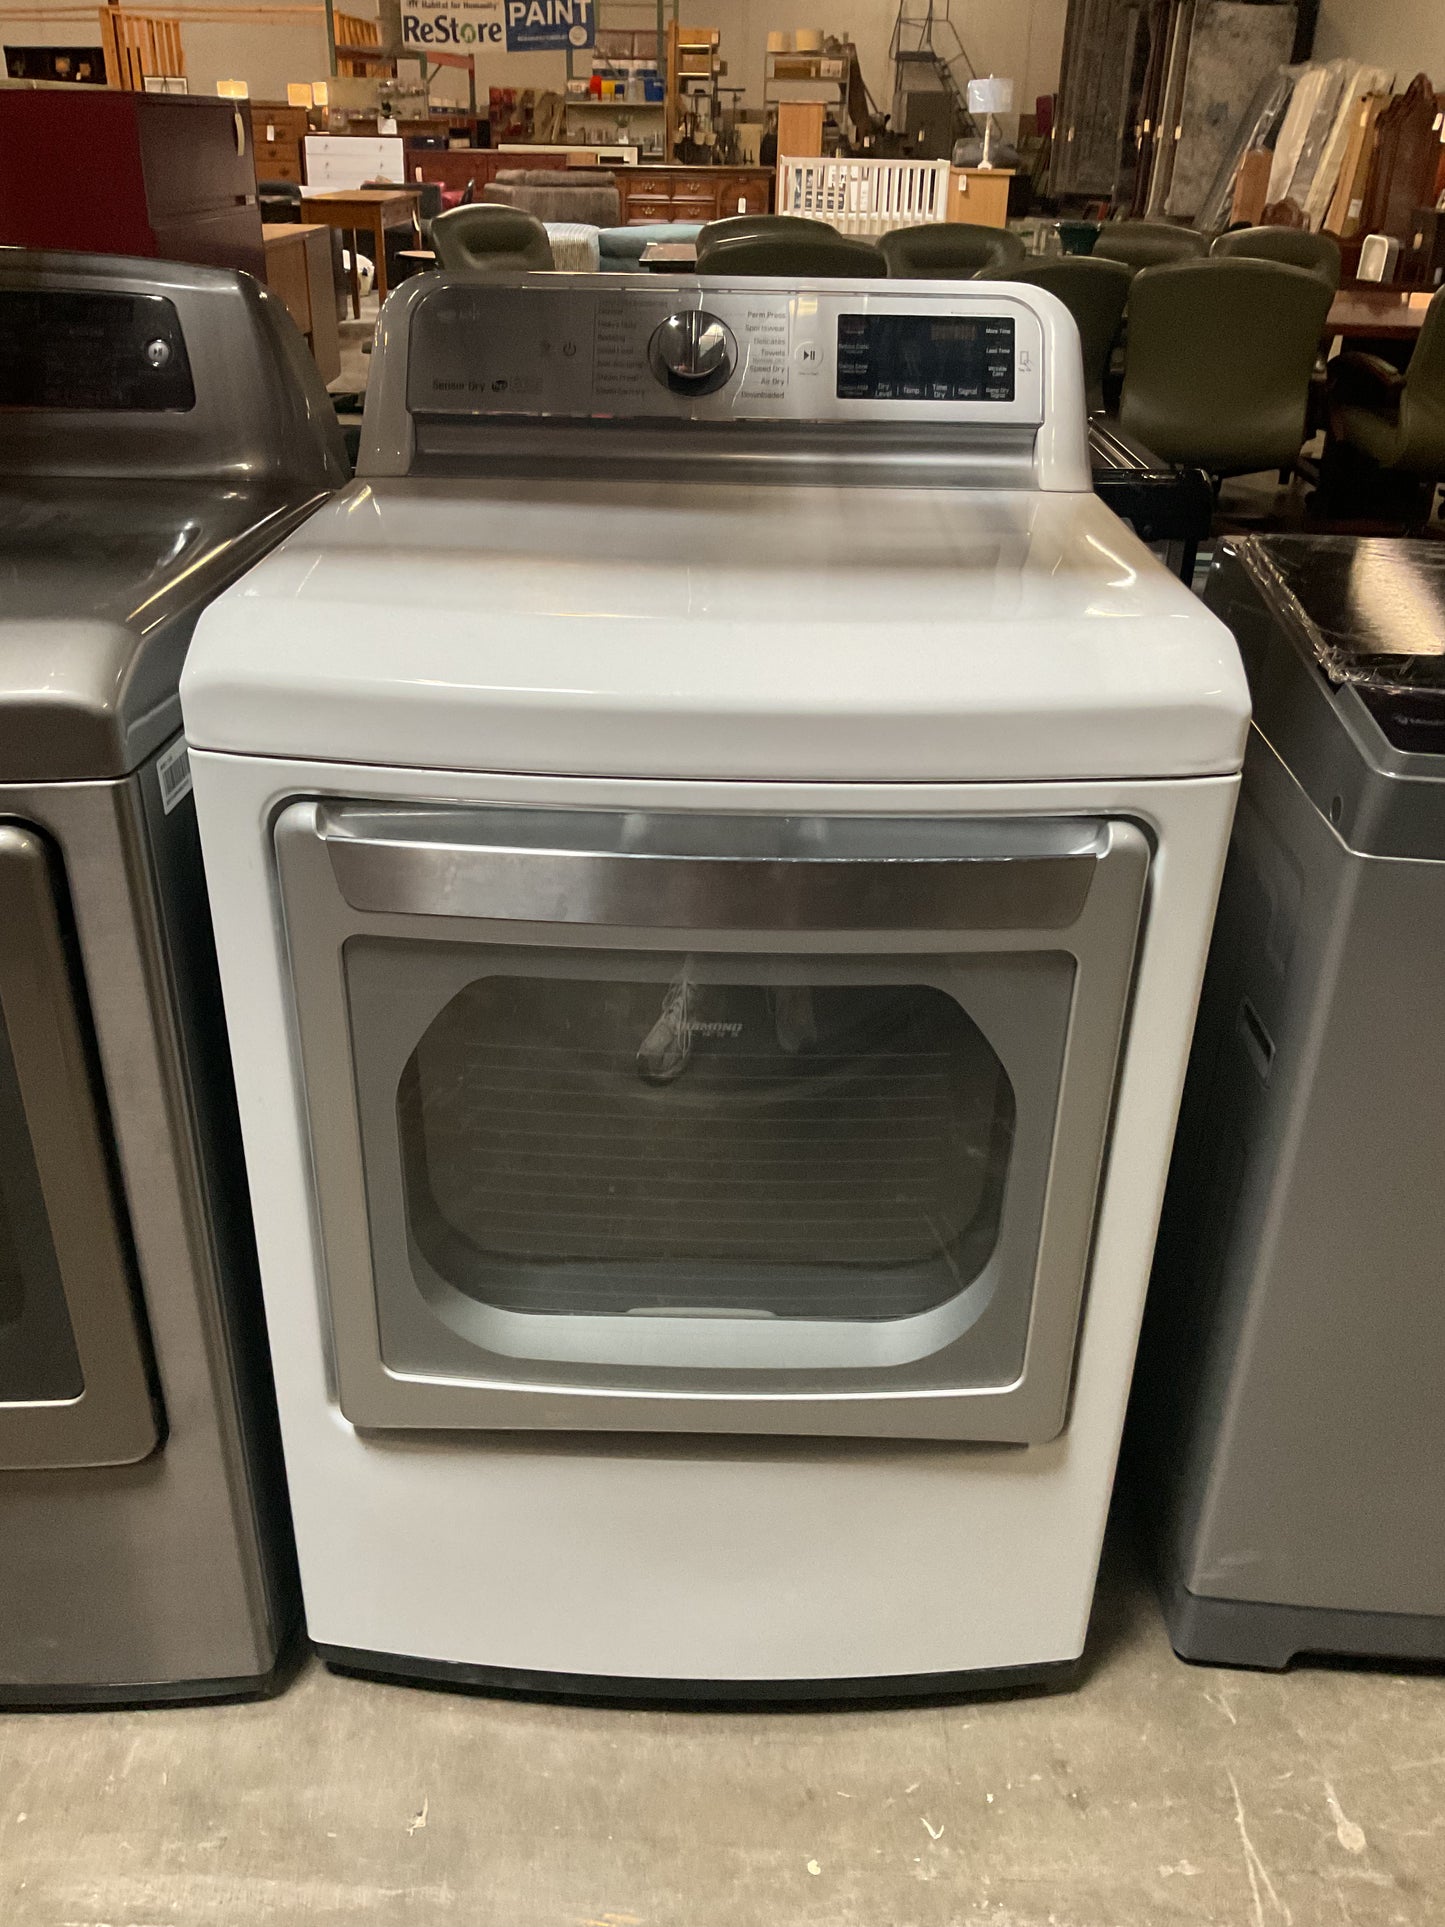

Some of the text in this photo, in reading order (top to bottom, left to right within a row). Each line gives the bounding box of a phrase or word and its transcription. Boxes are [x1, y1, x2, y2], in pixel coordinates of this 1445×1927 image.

[509, 0, 591, 27] PAINT
[403, 15, 502, 43] ReStore
[767, 311, 785, 319] Press
[745, 324, 785, 332] Sportswear
[753, 337, 785, 345] Delicates
[750, 365, 785, 373] Speed Dry
[772, 378, 785, 386] Dry
[468, 380, 485, 393] Dry
[903, 386, 920, 394] Temp
[934, 391, 946, 399] Dry
[958, 387, 978, 396] Signal
